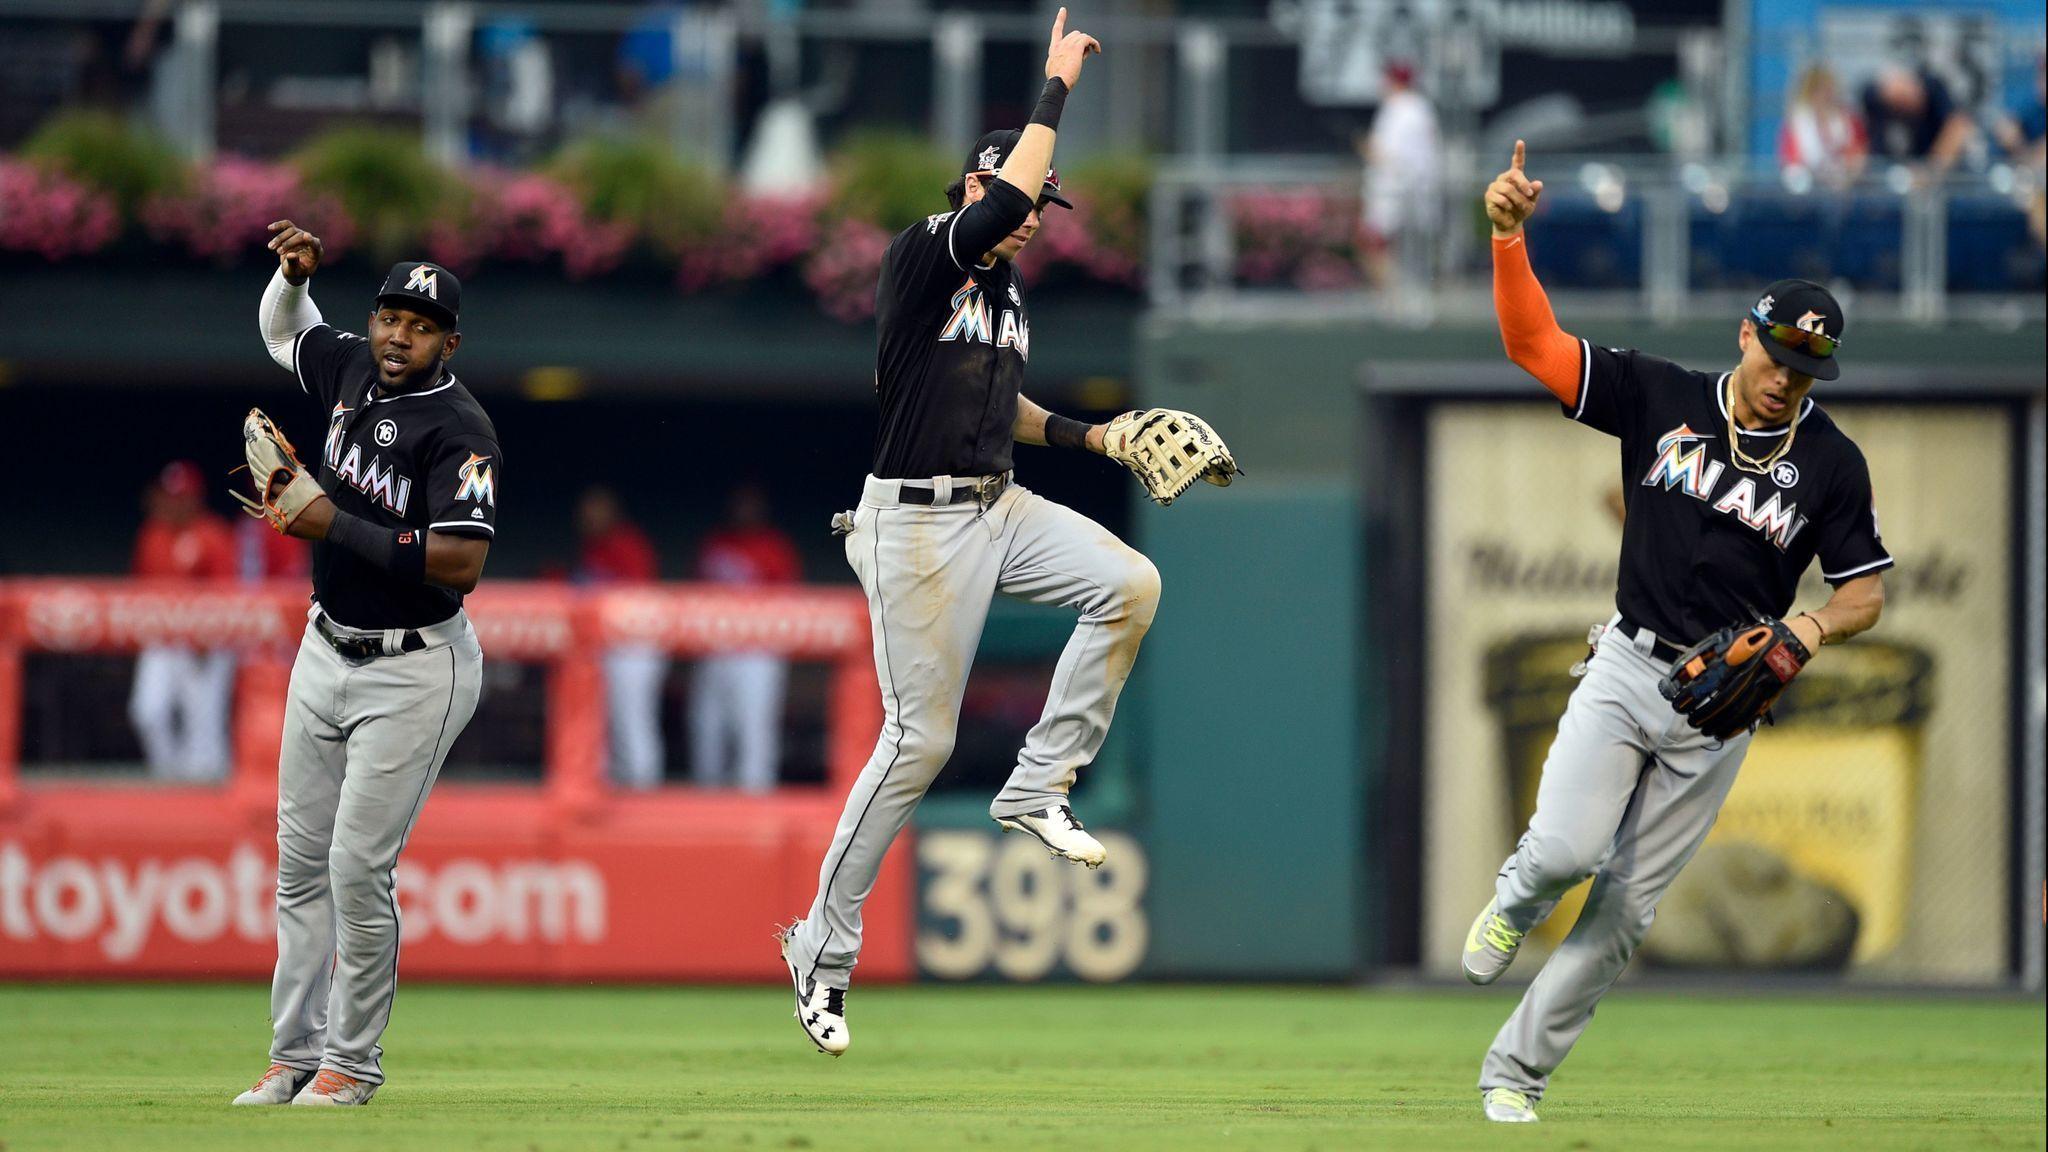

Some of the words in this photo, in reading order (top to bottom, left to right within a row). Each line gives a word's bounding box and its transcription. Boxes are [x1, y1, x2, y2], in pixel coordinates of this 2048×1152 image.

[378, 424, 393, 442] 16
[1776, 465, 1794, 484] 16
[1641, 436, 1809, 553] MIAMI
[398, 531, 413, 544] 13
[916, 832, 1149, 981] 398
